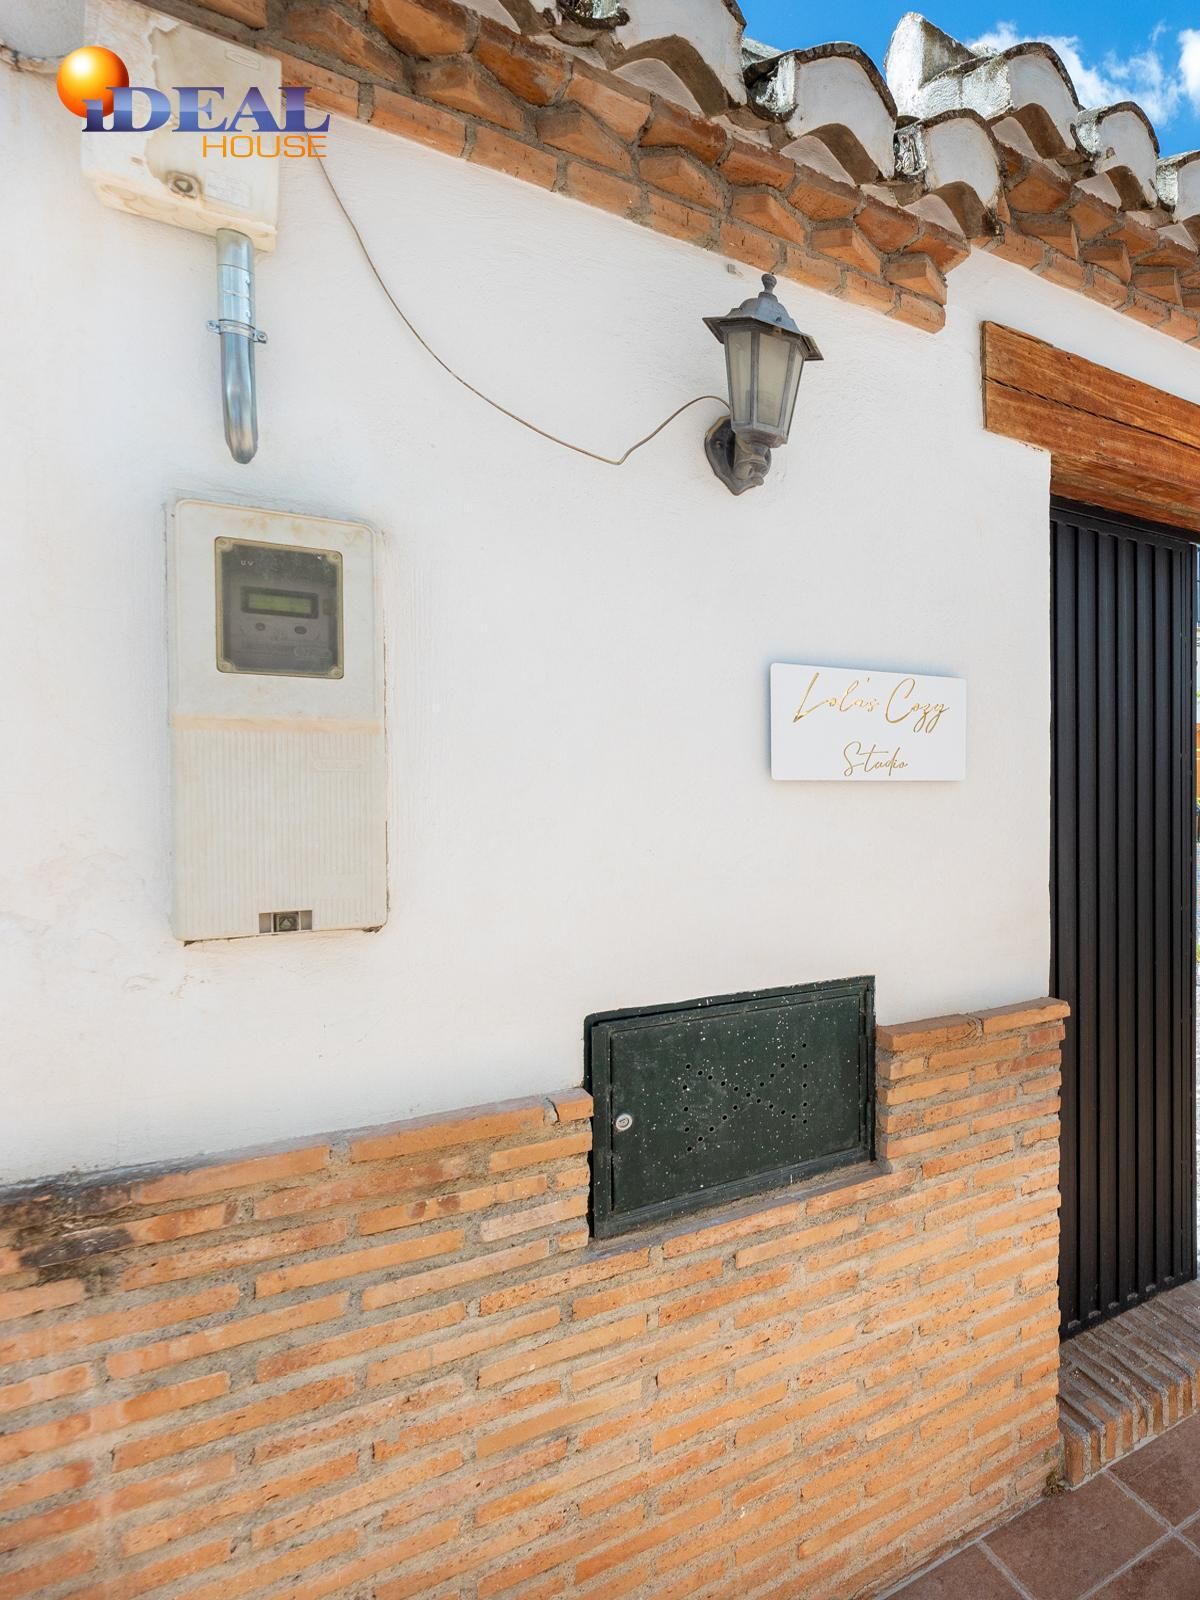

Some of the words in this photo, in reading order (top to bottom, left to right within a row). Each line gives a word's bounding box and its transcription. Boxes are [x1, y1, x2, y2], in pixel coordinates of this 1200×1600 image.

[793, 672, 880, 722] Lola's
[885, 678, 949, 733] Cozy
[843, 740, 909, 777] Studio
